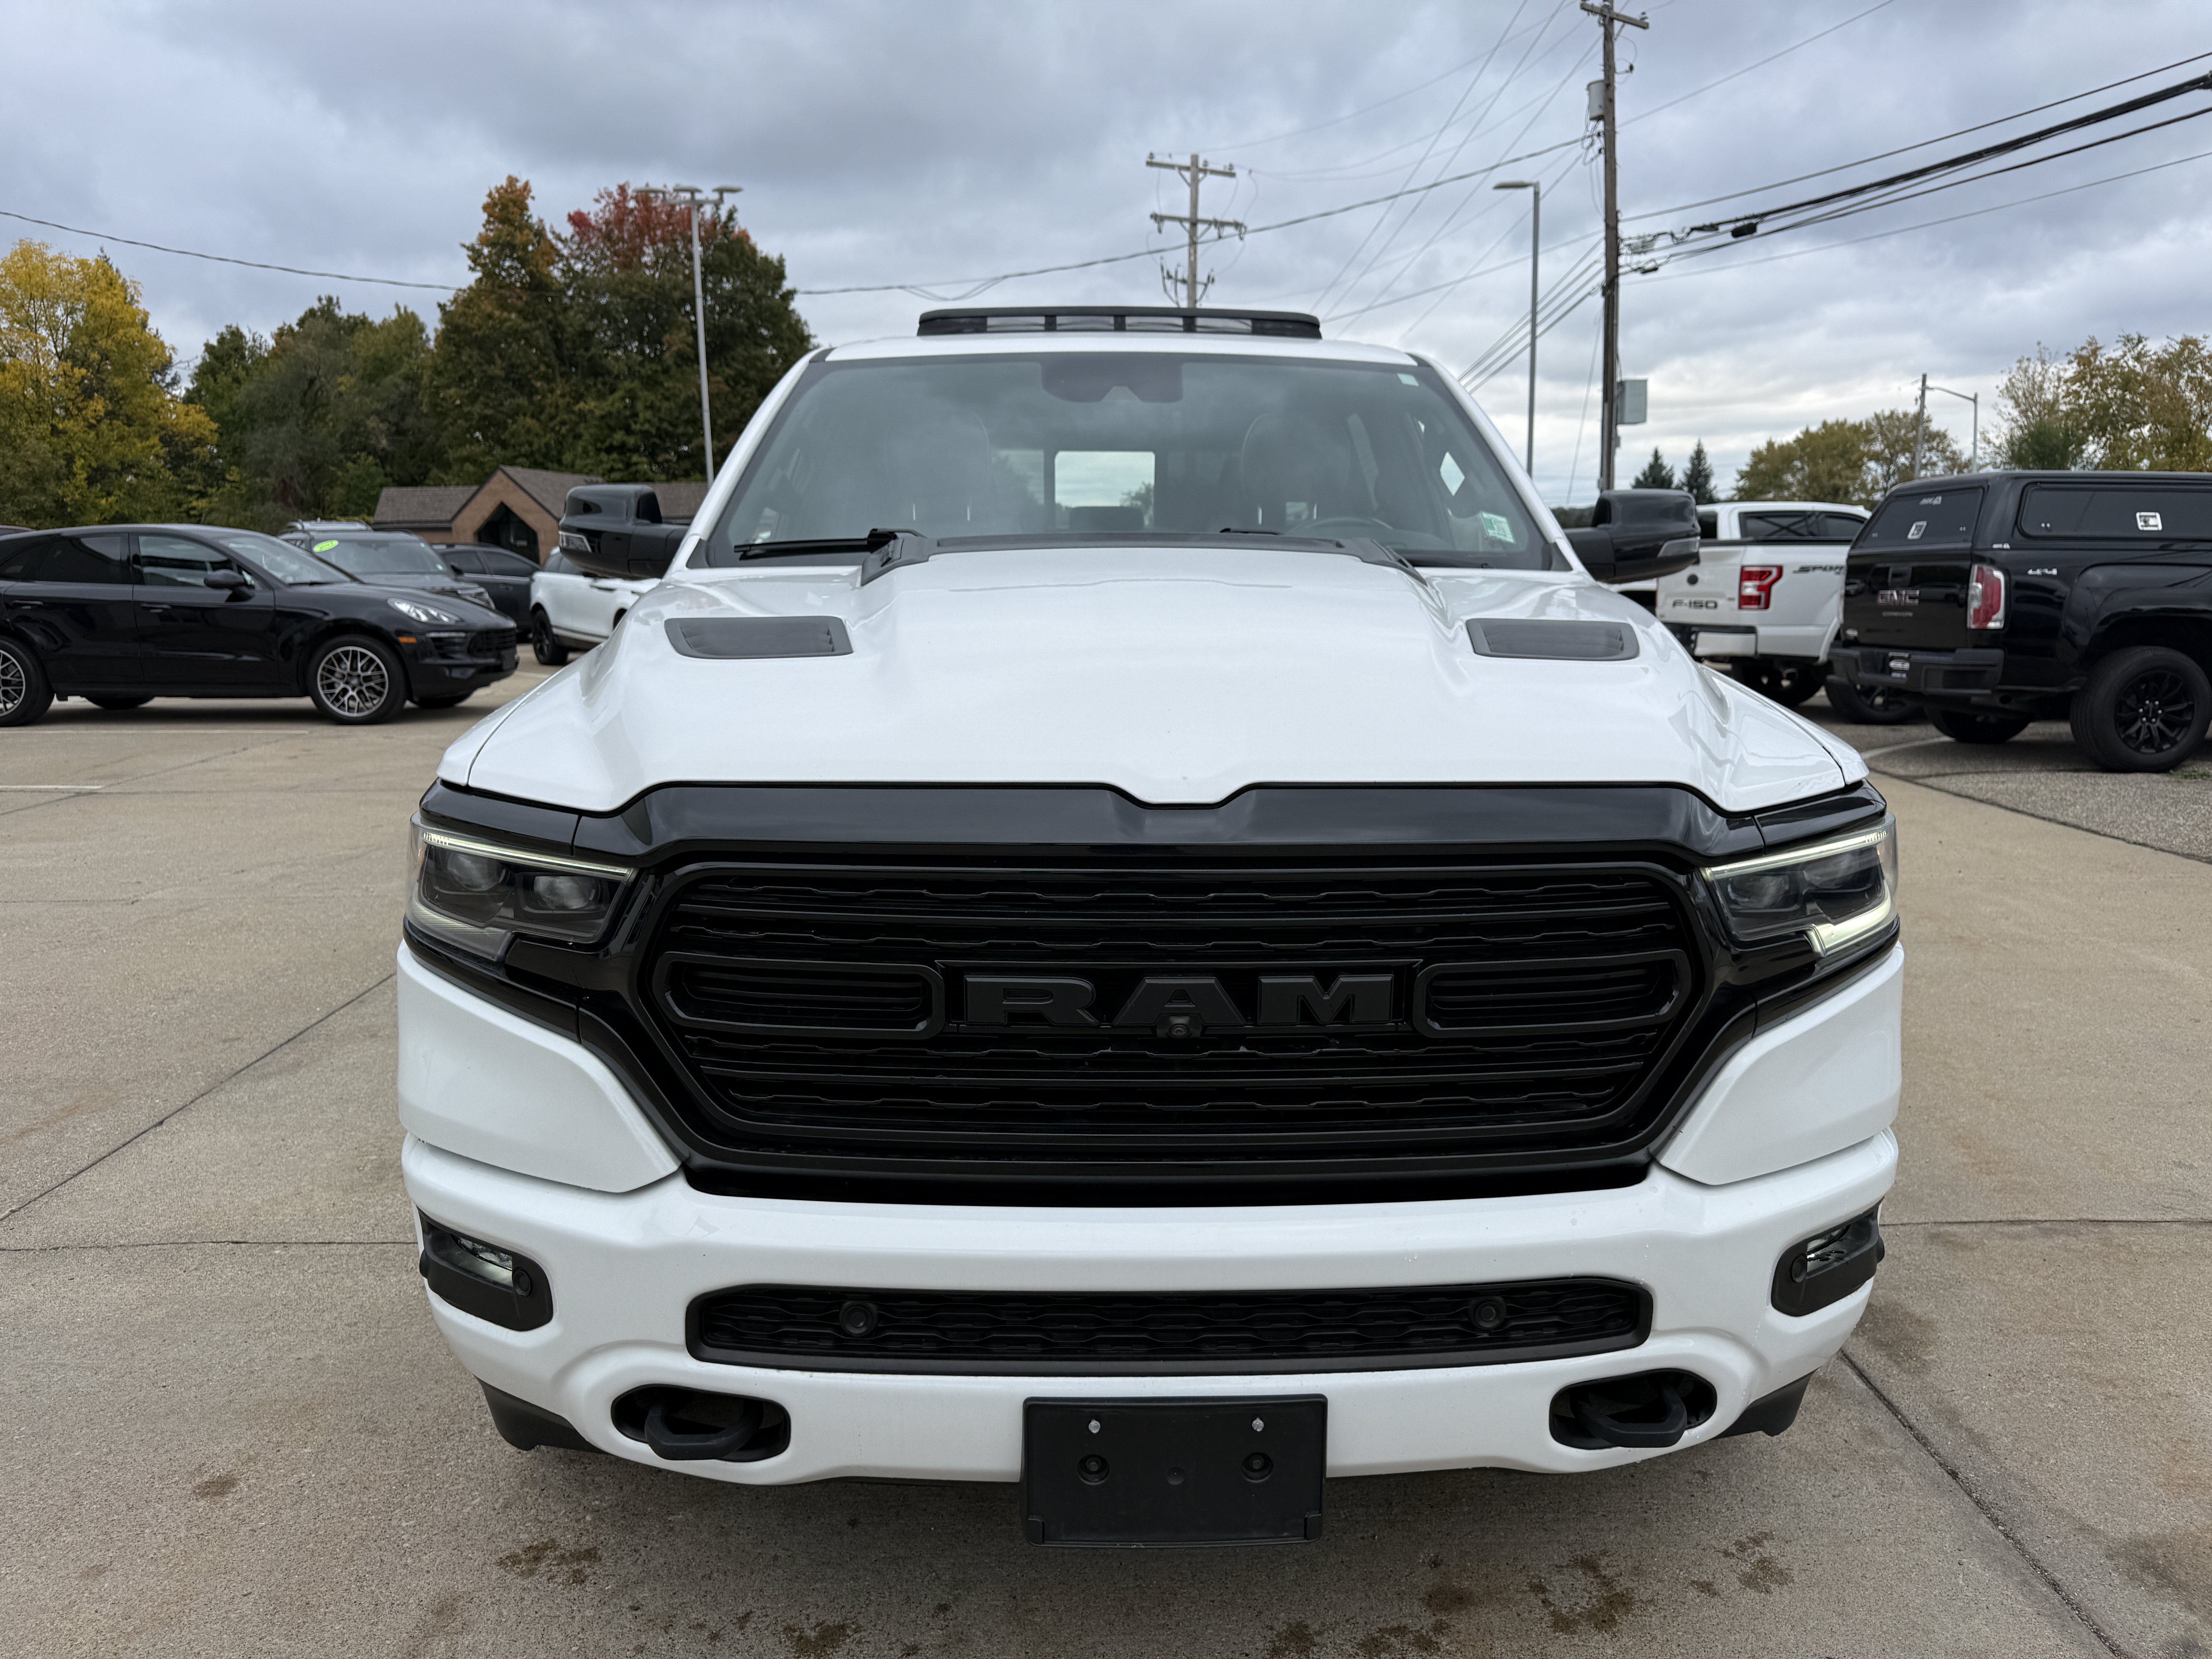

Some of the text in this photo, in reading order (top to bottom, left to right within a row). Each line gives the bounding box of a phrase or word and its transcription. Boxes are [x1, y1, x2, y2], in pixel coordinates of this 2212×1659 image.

[1793, 565, 1845, 574] SPOR
[1672, 599, 1717, 609] F-150
[1878, 590, 1920, 606] GMC
[964, 975, 1395, 1026] RAM
